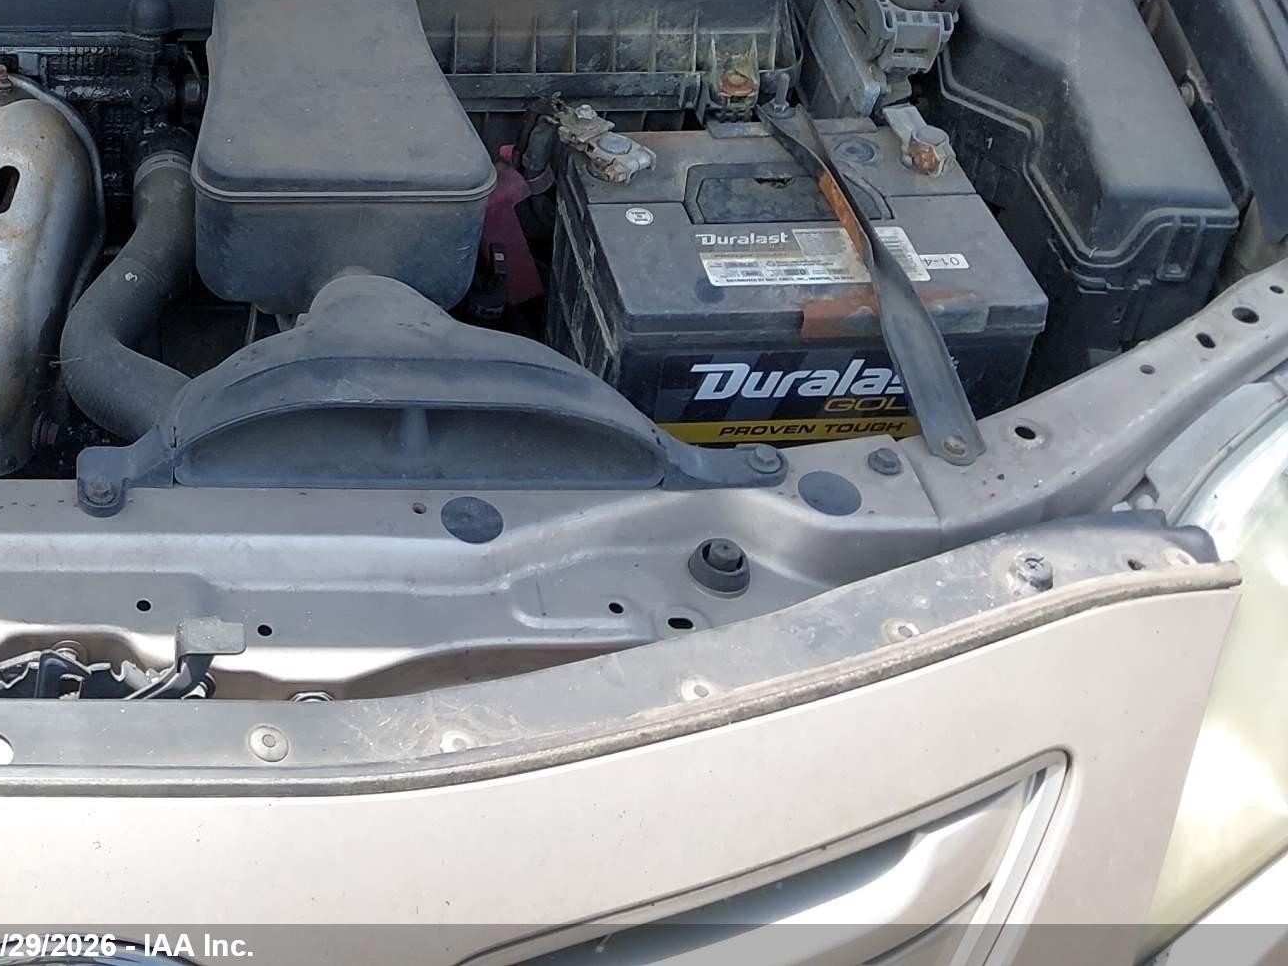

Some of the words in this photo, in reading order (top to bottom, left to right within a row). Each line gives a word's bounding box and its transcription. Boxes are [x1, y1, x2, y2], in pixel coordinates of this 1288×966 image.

[695, 232, 789, 246] Duralast
[718, 422, 816, 437] PROVEN
[824, 421, 904, 434] TOUGH
